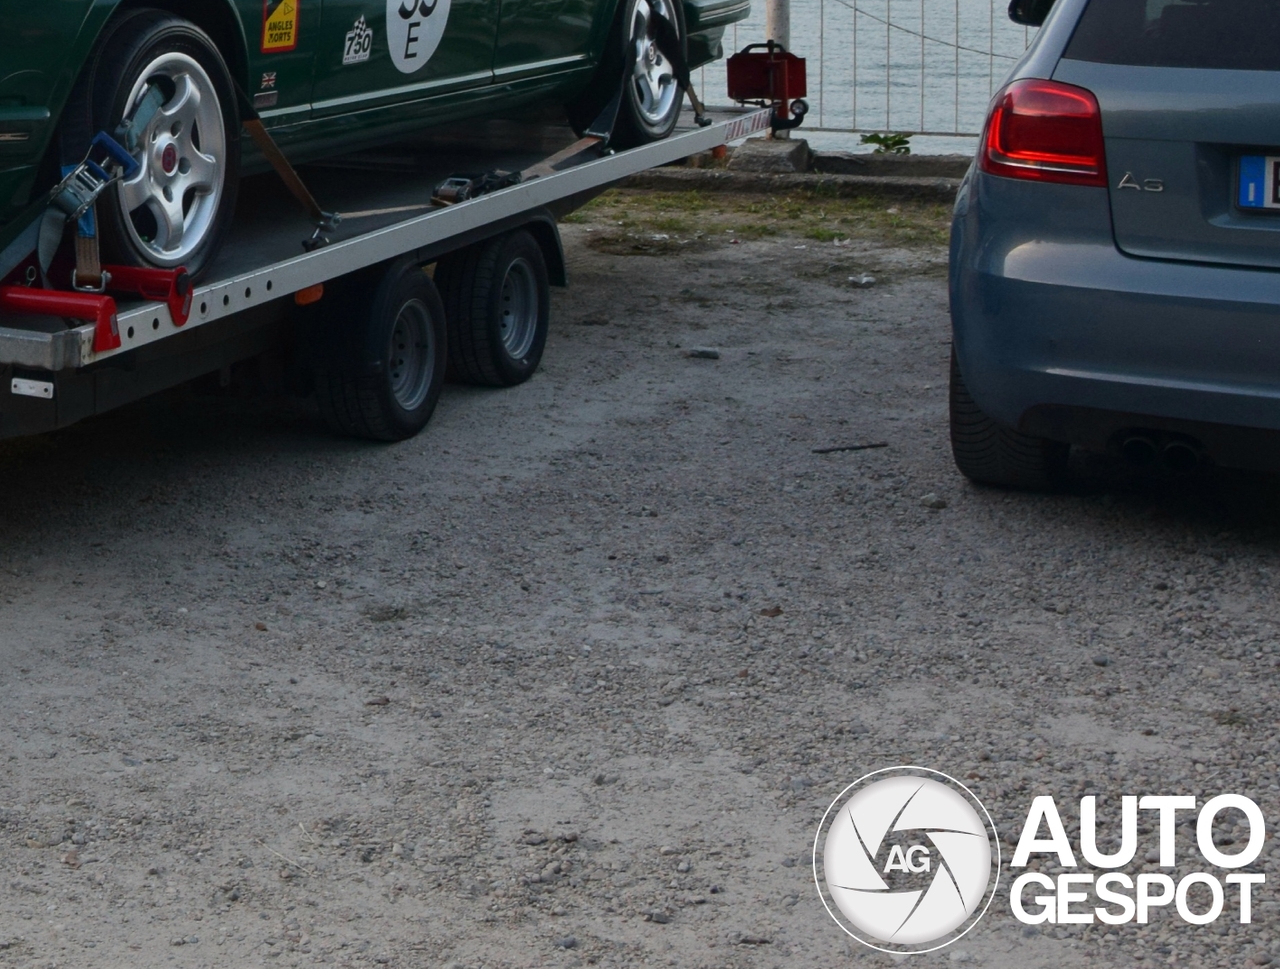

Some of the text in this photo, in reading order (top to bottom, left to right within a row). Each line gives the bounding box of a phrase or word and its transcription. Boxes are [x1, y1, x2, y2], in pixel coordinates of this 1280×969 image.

[268, 20, 293, 32] ANGLES
[346, 33, 371, 56] 750
[404, 21, 421, 59] E
[1117, 171, 1164, 192] A3
